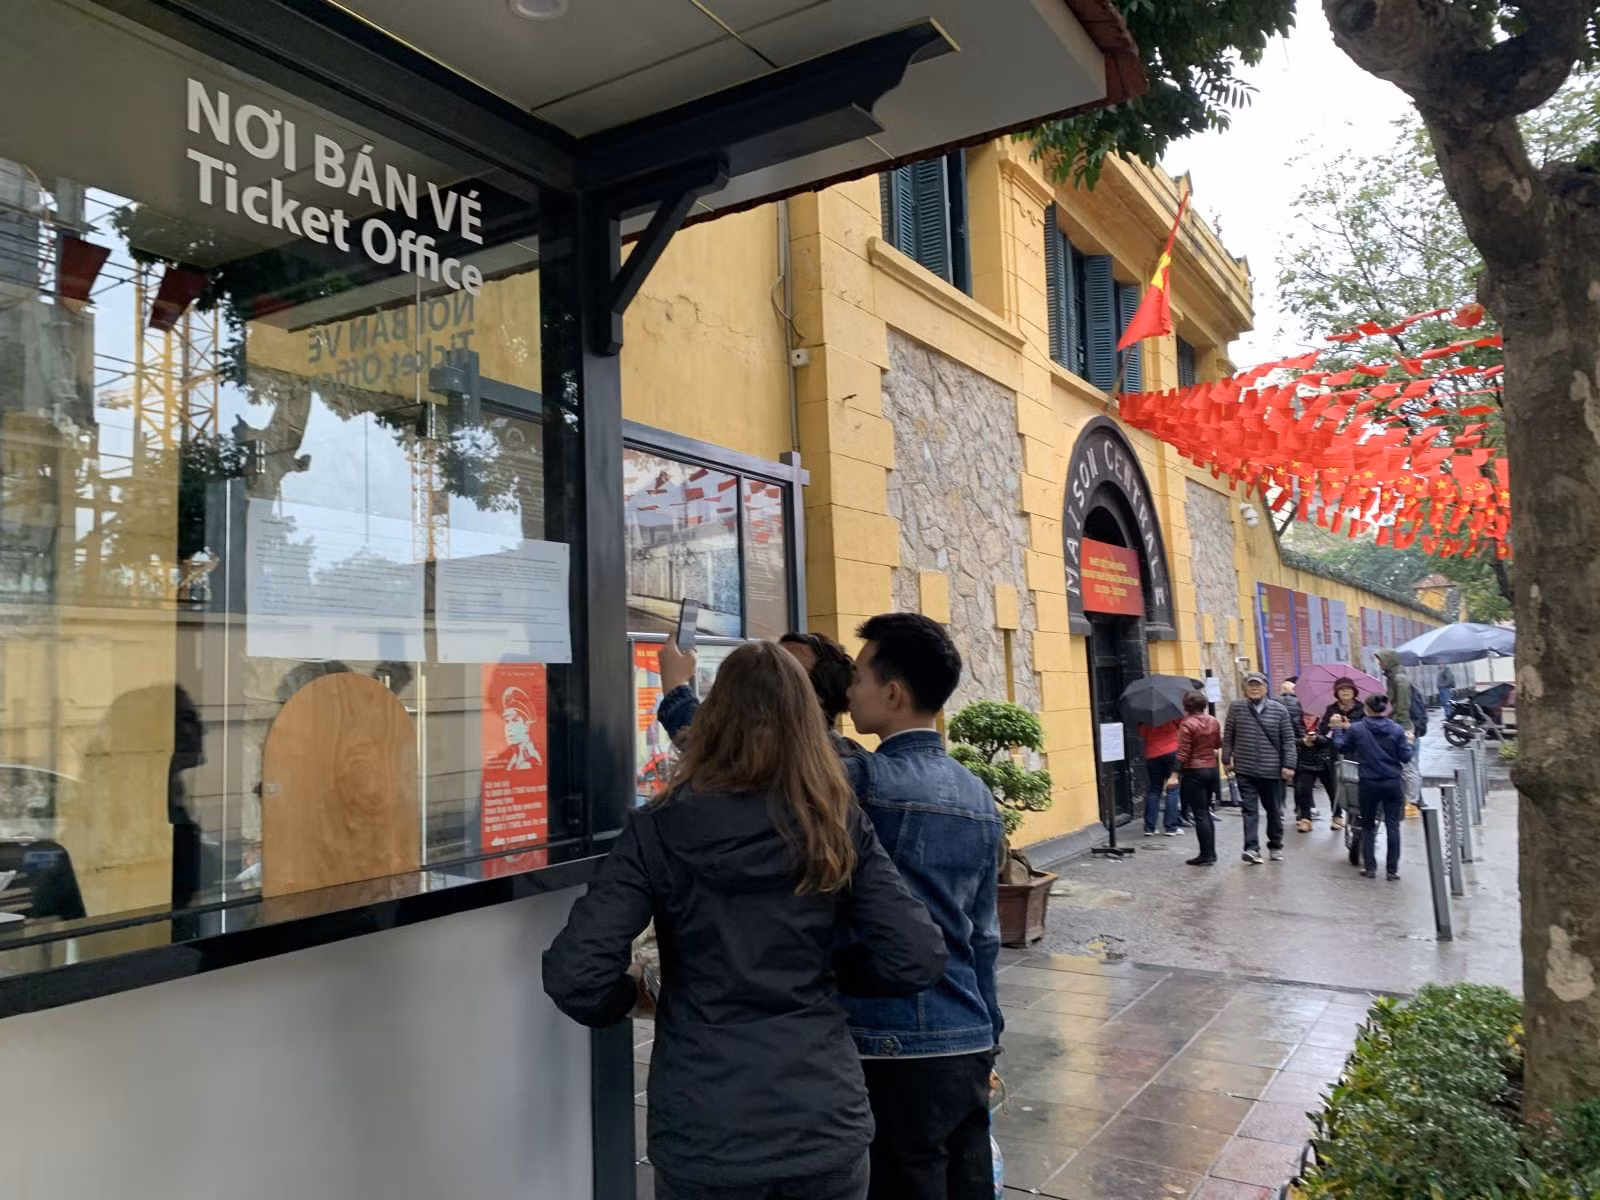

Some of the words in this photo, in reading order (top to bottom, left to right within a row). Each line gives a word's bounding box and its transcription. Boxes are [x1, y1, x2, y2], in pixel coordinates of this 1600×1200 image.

[187, 78, 296, 172] NƠI
[314, 133, 418, 220] BÁN
[427, 181, 483, 245] VÉ
[187, 148, 350, 252] Ticket
[361, 218, 483, 296] Office
[1065, 447, 1099, 597] MAISON
[1103, 440, 1166, 606] CENTRALE
